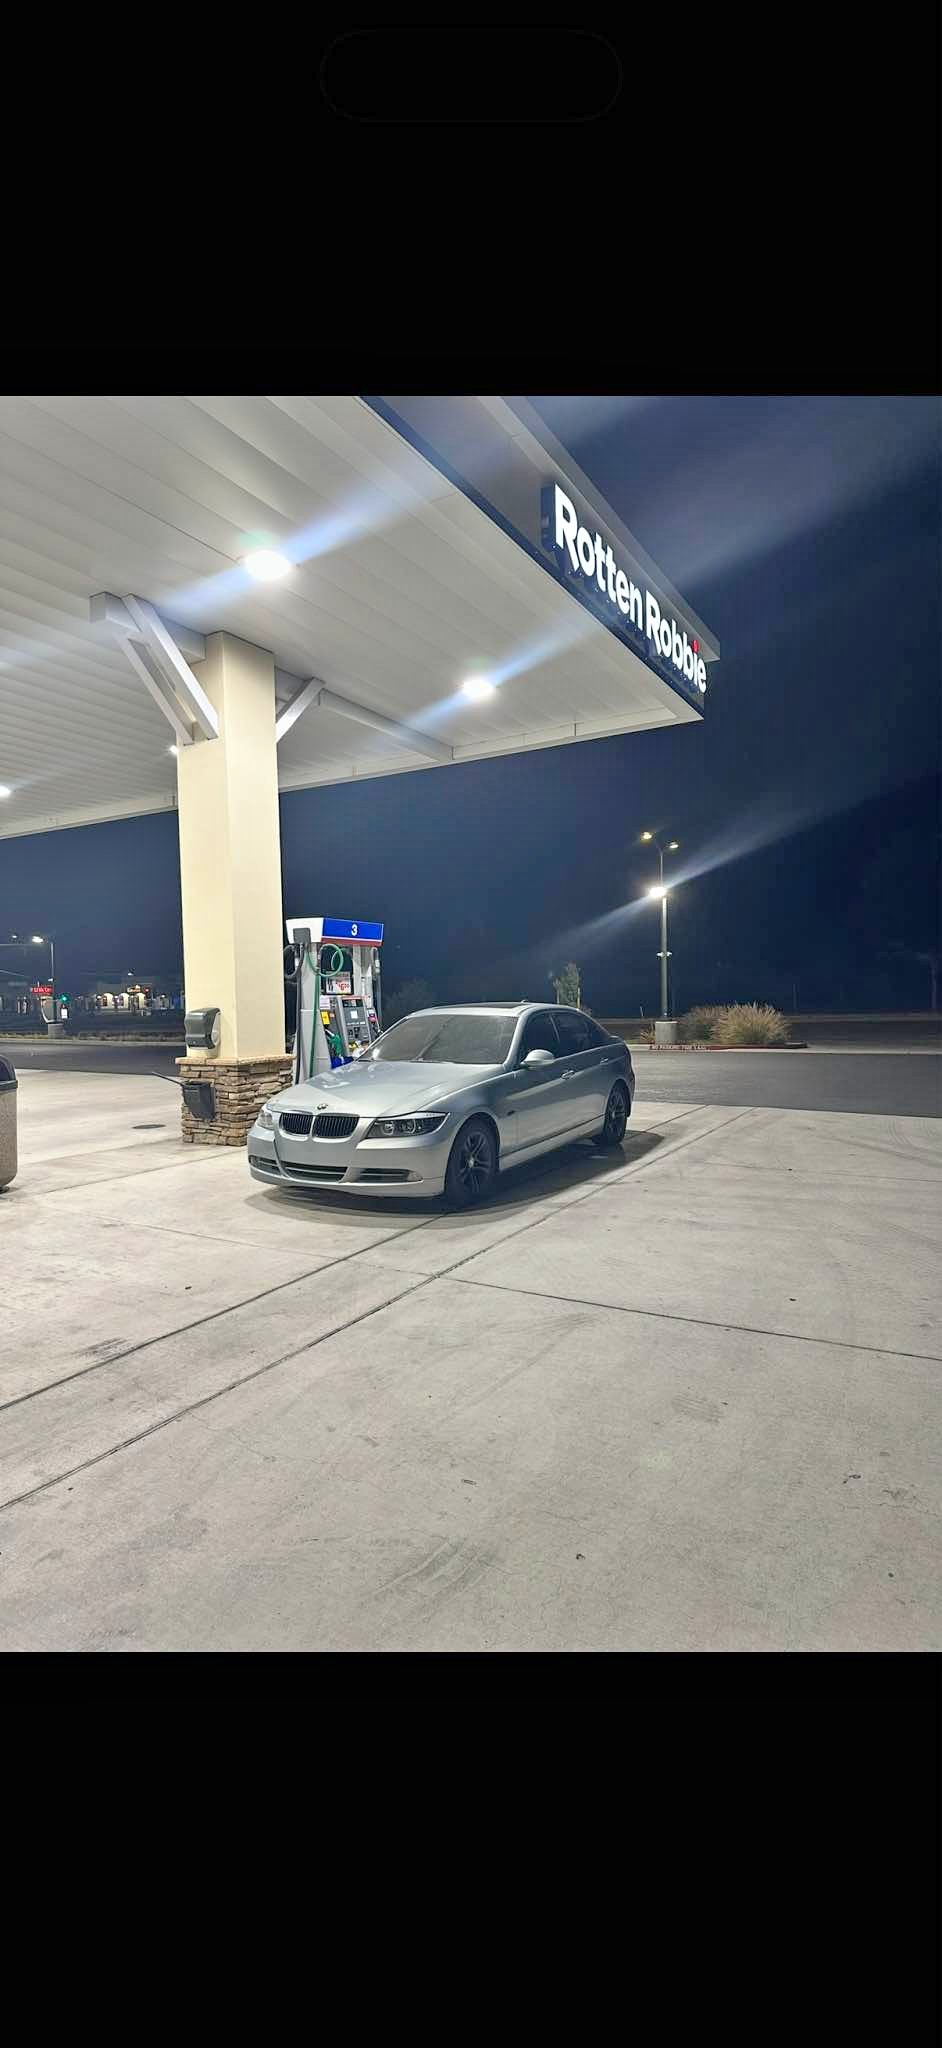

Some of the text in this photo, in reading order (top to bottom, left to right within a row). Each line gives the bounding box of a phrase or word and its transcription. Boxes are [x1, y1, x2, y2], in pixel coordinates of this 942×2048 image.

[555, 484, 707, 693] Rotten Robbie
[351, 924, 358, 936] 3
